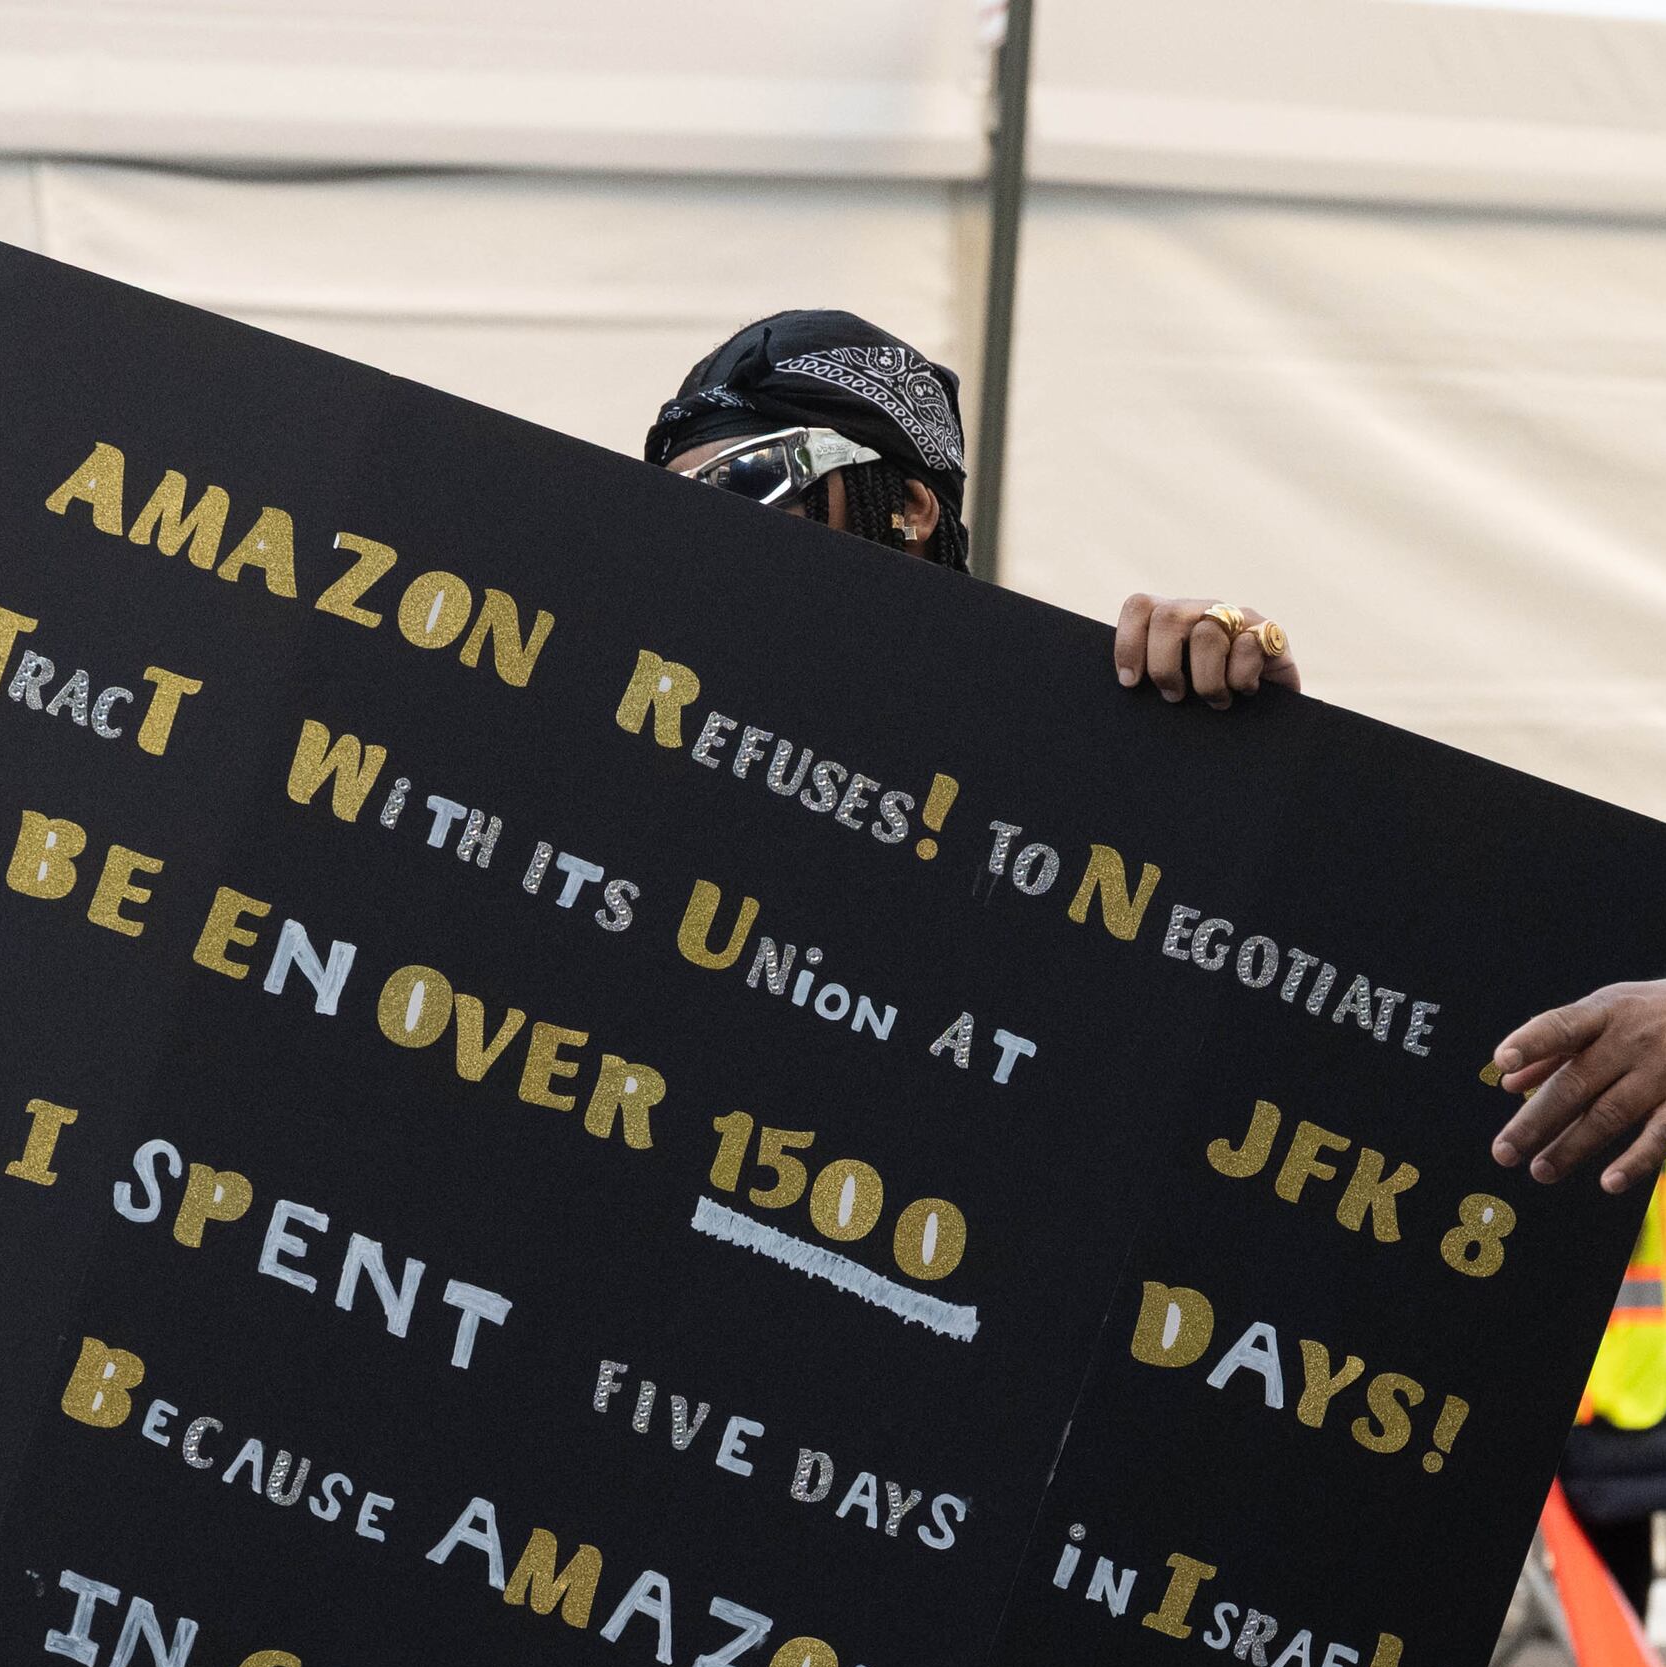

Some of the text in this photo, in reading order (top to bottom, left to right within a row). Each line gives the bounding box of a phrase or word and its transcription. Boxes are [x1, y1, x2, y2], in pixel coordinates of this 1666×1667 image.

[46, 443, 1441, 1057] AMAZON REFUSES! TO NEGOTIATE
[378, 966, 667, 1151] OVER
[698, 1112, 967, 1281] 1500
[1131, 1283, 1470, 1474] DAYS!
[523, 842, 641, 933] ITS
[930, 1013, 1037, 1085] AT
[1208, 1101, 1420, 1243] JFK
[1441, 1195, 1517, 1278] 8
[6, 1100, 79, 1187] I
[114, 1140, 513, 1371] SPENT
[594, 1361, 765, 1478] FIVE
[791, 1449, 967, 1551] DAYS
[62, 1338, 396, 1543] BECAUSE
